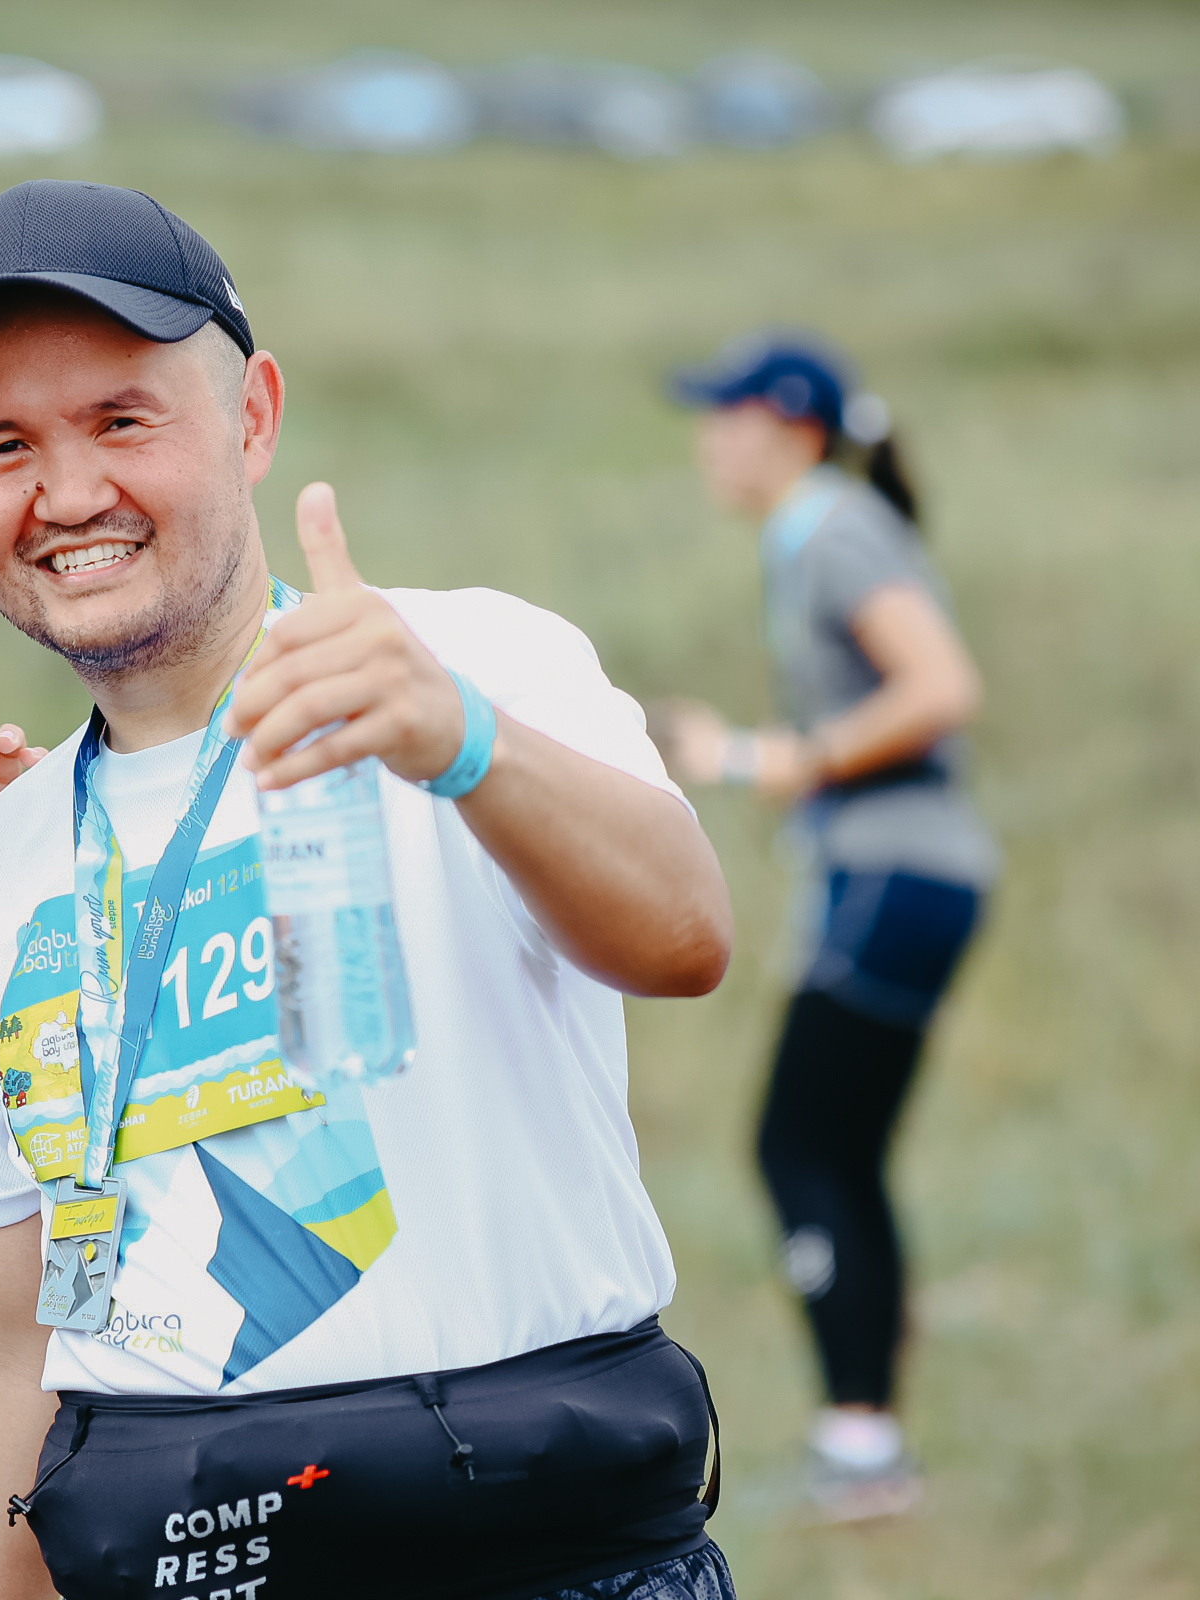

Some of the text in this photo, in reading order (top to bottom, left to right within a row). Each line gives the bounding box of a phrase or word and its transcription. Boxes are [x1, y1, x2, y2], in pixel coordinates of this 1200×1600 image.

[217, 868, 240, 896] 12
[108, 899, 117, 930] steppe
[27, 929, 78, 956] aqbu
[42, 1046, 60, 1057] bay
[226, 1073, 294, 1104] TURAN
[177, 1107, 208, 1124] ZEBRA
[164, 1491, 282, 1542] COMP
[154, 1535, 271, 1587] RESS
